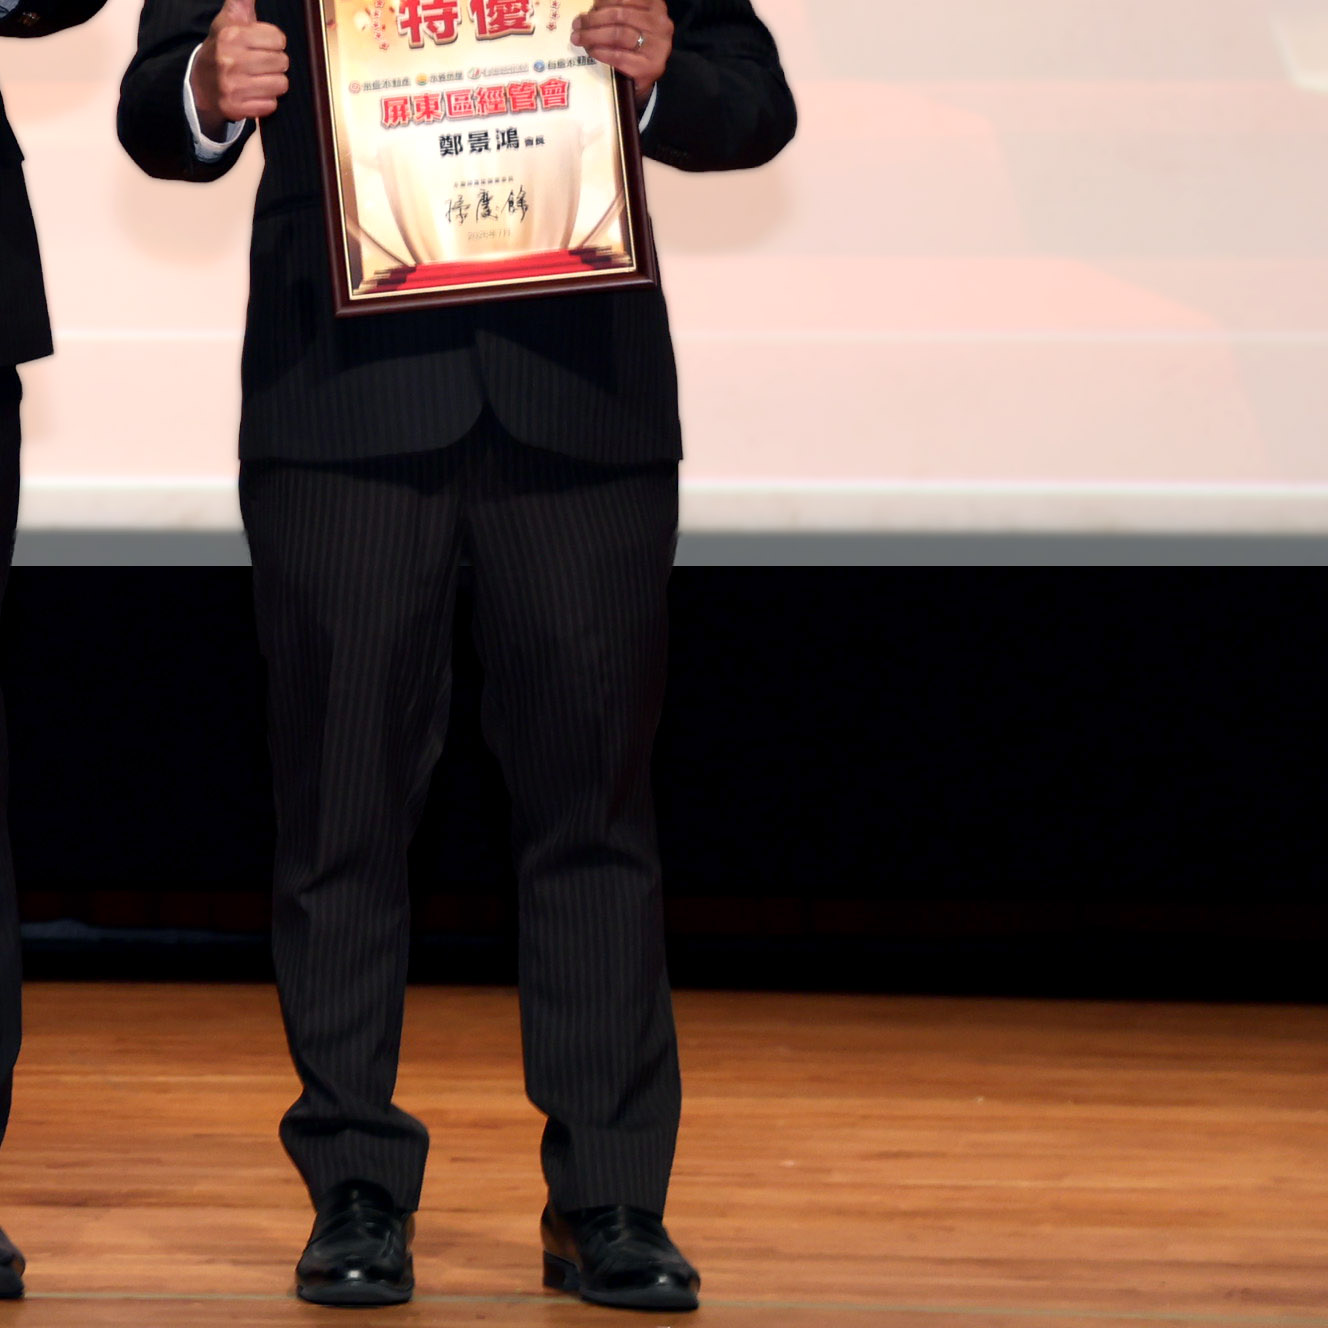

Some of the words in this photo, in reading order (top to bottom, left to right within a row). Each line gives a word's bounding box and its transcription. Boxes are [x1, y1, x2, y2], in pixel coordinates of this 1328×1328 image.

[381, 76, 571, 129] 屏東區經管會
